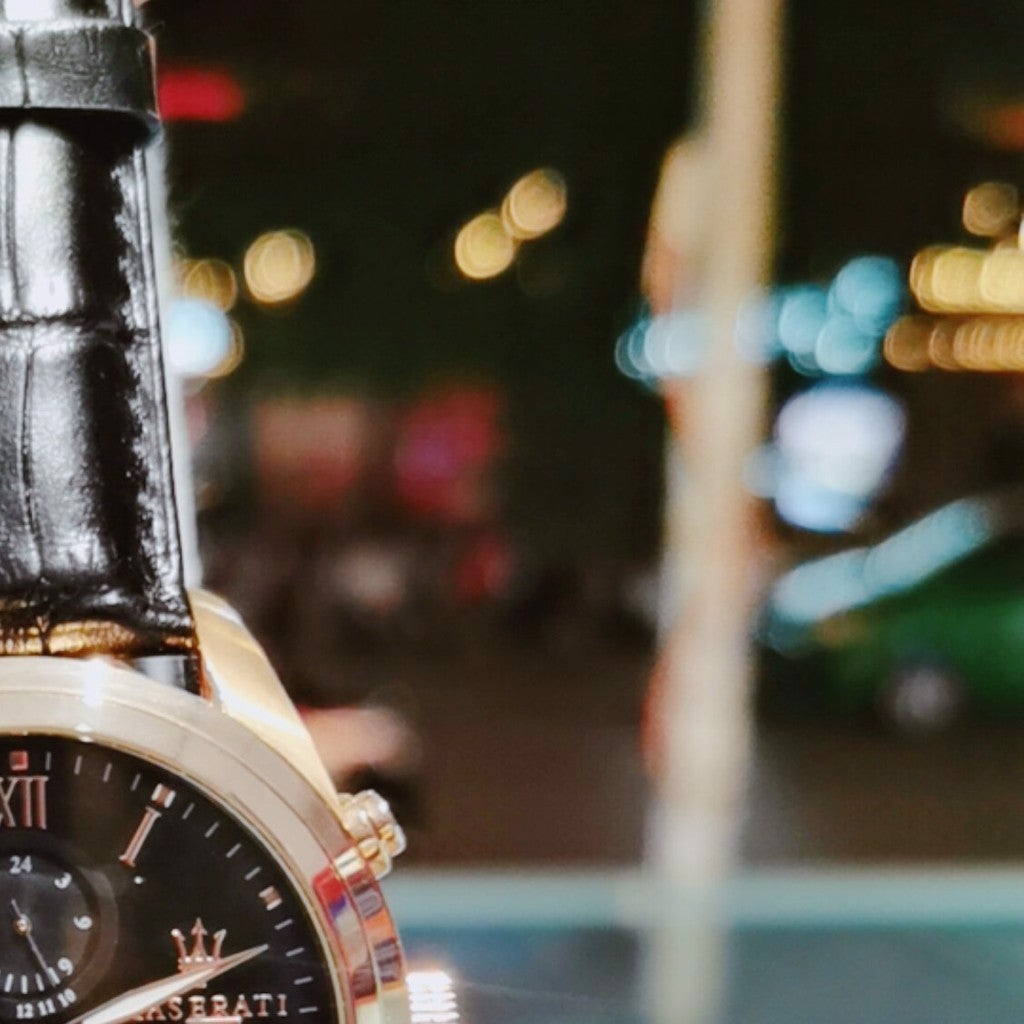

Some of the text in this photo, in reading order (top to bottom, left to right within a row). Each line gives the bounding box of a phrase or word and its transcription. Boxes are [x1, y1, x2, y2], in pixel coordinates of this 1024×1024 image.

[119, 806, 162, 868] I
[9, 856, 32, 874] 24
[54, 872, 72, 889] 3
[58, 988, 77, 1008] 10
[16, 1004, 34, 1019] 12
[37, 1002, 56, 1018] 11
[133, 993, 288, 1022] ASERATI
